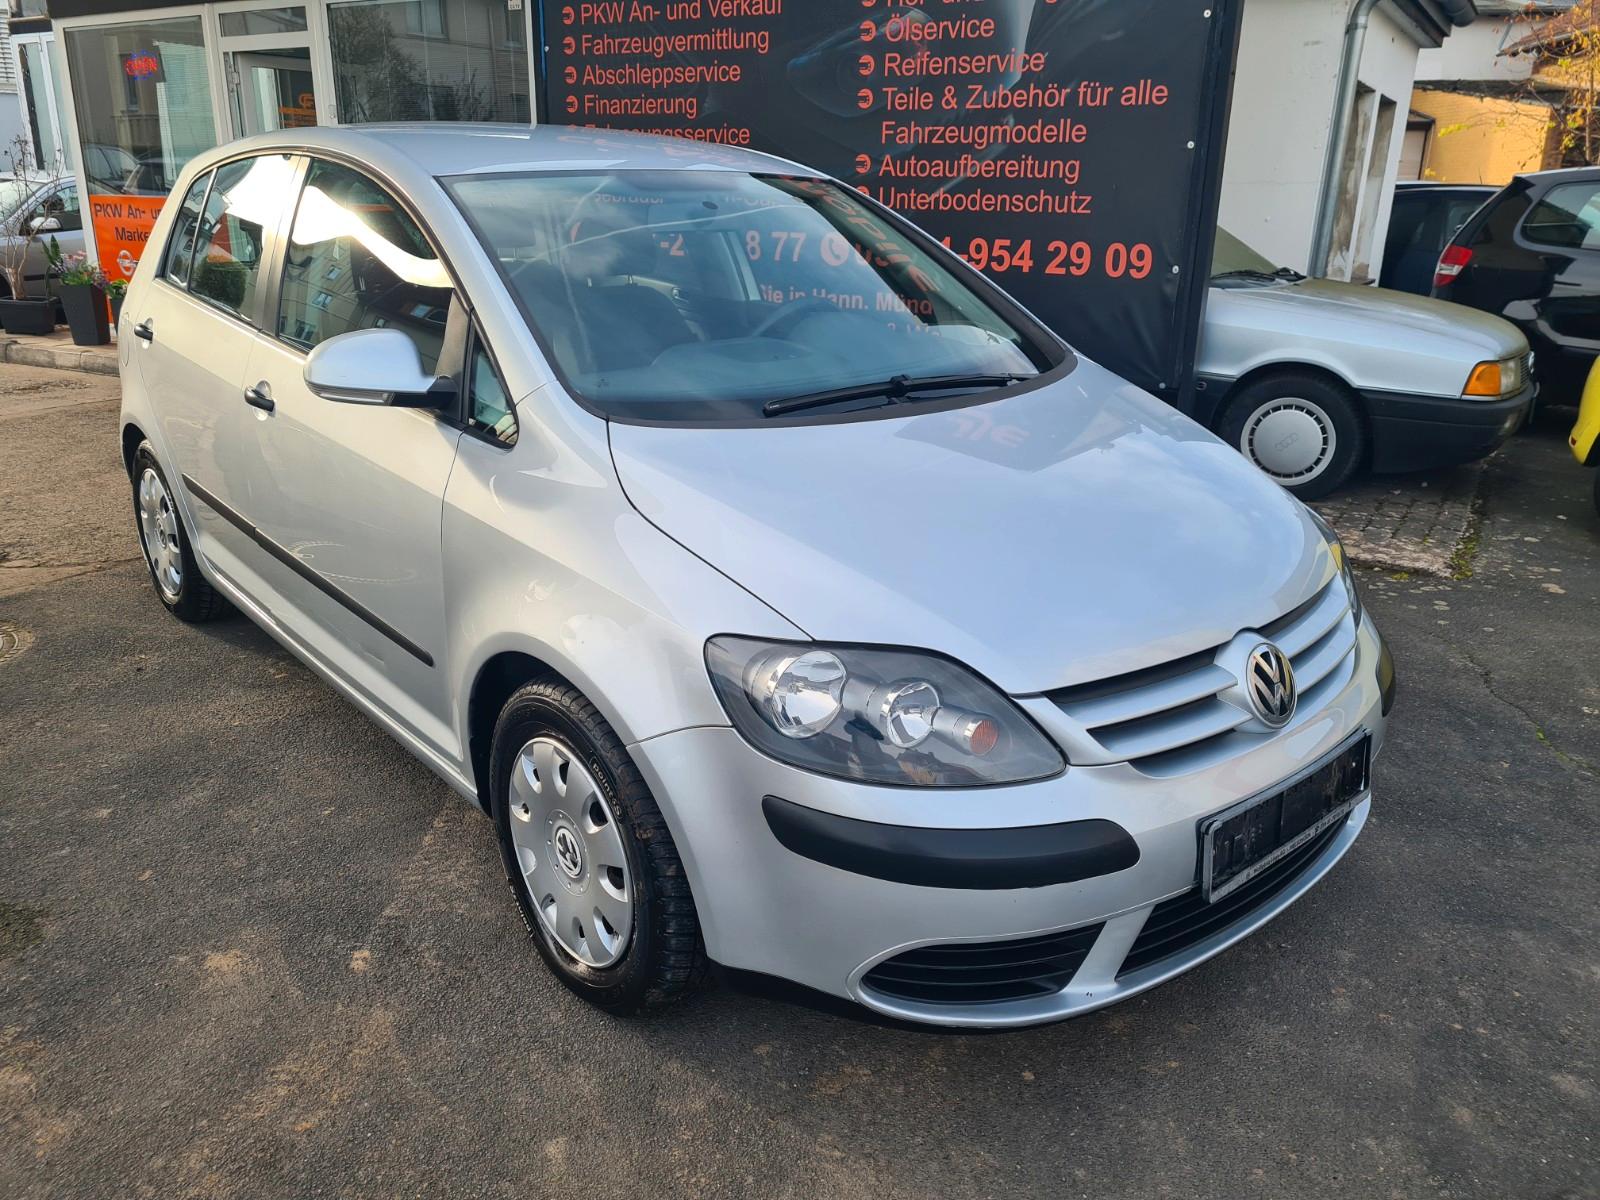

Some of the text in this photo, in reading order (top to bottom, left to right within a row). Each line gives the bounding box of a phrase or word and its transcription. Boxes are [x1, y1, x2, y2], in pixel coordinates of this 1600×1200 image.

[580, 3, 625, 24] PKW
[629, 0, 659, 21] An-
[666, 0, 701, 20] und
[885, 15, 995, 43] Ölservice
[581, 29, 769, 58] Fahrzeugvermittlung
[583, 61, 741, 88] Abschleppservice
[884, 49, 1045, 77] Reifenservice
[585, 94, 698, 119] Finanzierung
[883, 80, 1169, 110] Teile & Zubehör für alle
[881, 119, 1087, 150] Fahrzeugmodelle
[879, 155, 1081, 184] Autoaufbereitung
[94, 203, 122, 218] PKW
[127, 205, 145, 219] An-
[880, 187, 1093, 214] Unterbodenschutz
[771, 232, 807, 262] 77
[1045, 240, 1092, 277] 29
[1105, 242, 1153, 279] 09
